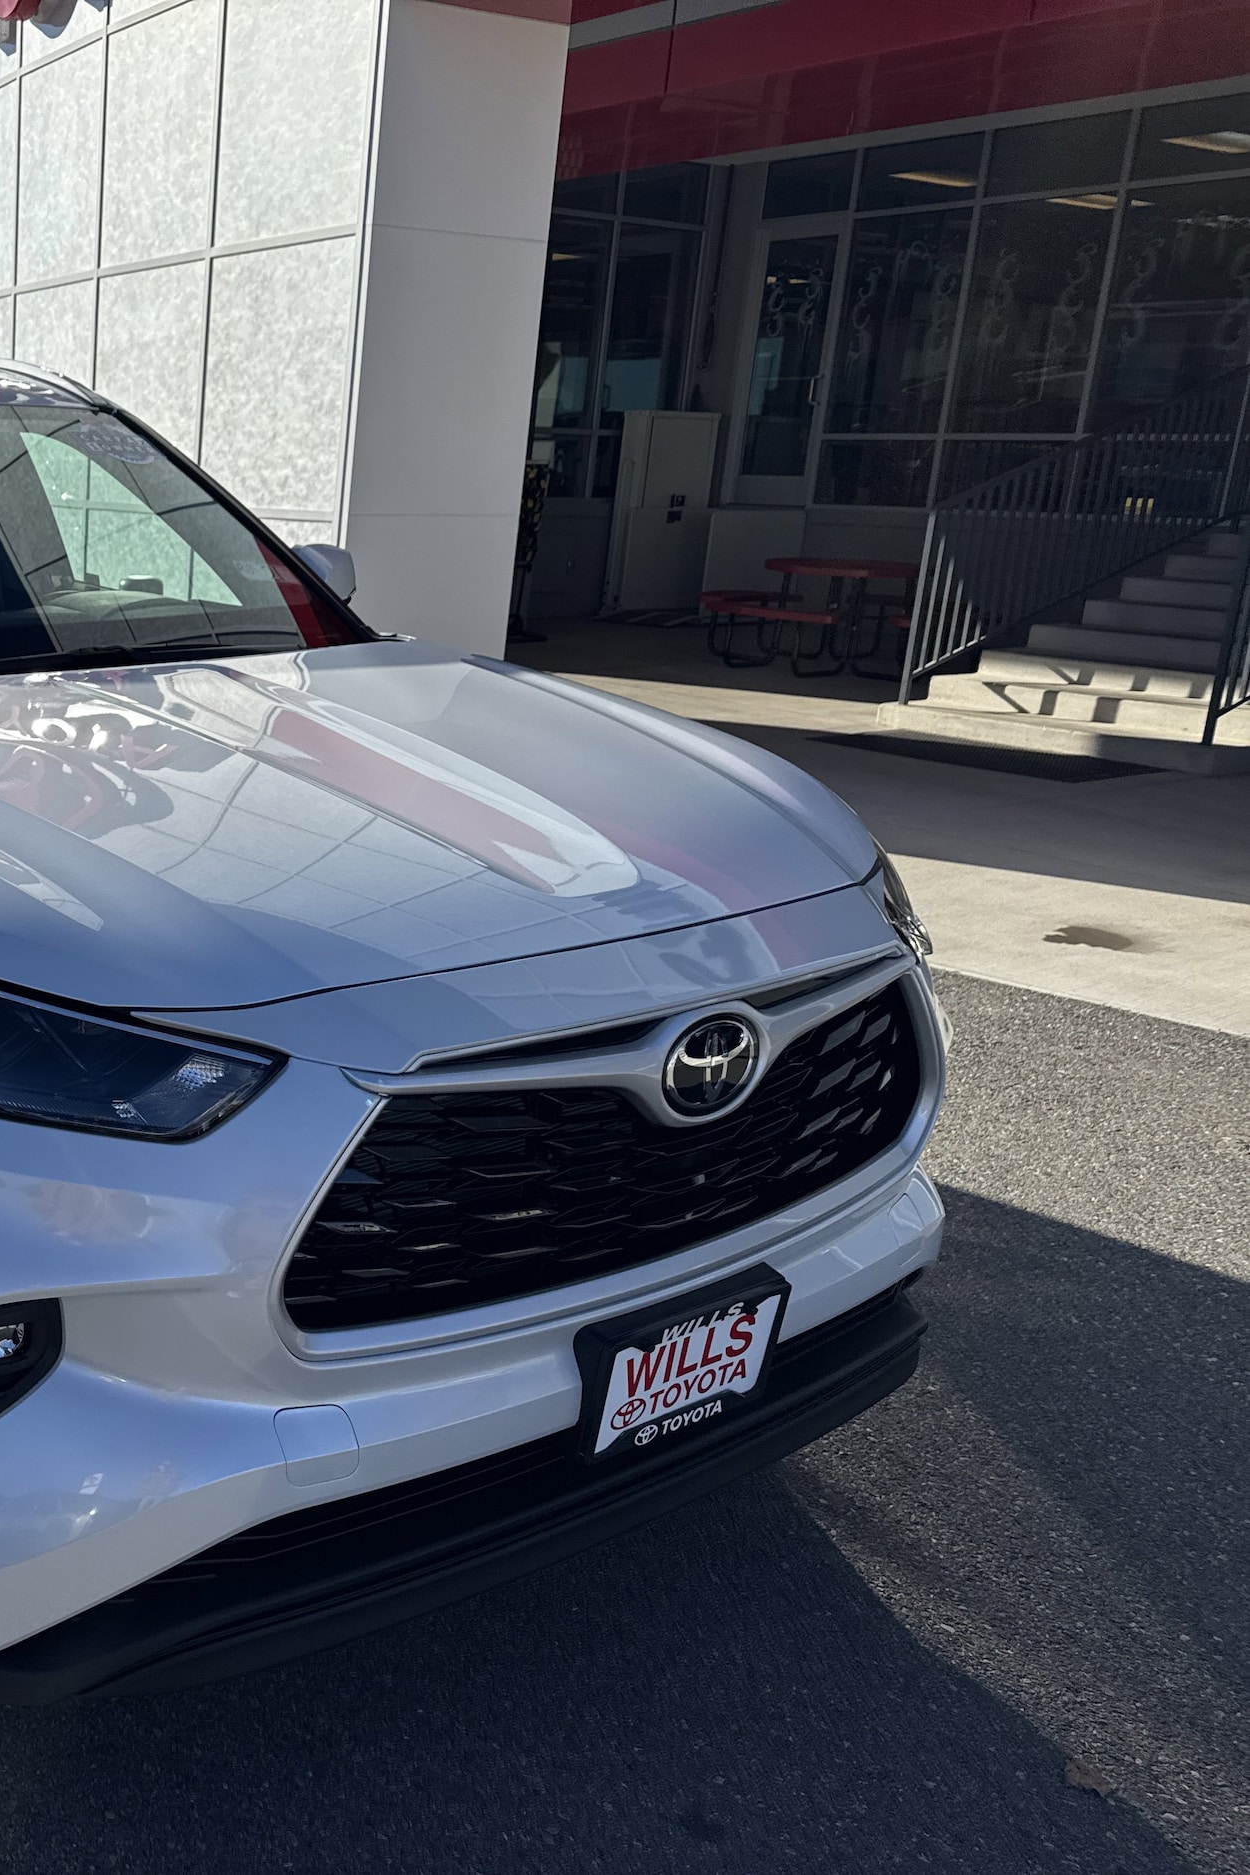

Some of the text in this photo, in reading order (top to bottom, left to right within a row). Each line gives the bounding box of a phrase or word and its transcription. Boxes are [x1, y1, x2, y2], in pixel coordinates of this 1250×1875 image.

[661, 1302, 744, 1343] WILLS
[626, 1313, 756, 1398] WILLS
[650, 1359, 746, 1415] TOYOTA
[661, 1400, 723, 1435] TOYOTA
